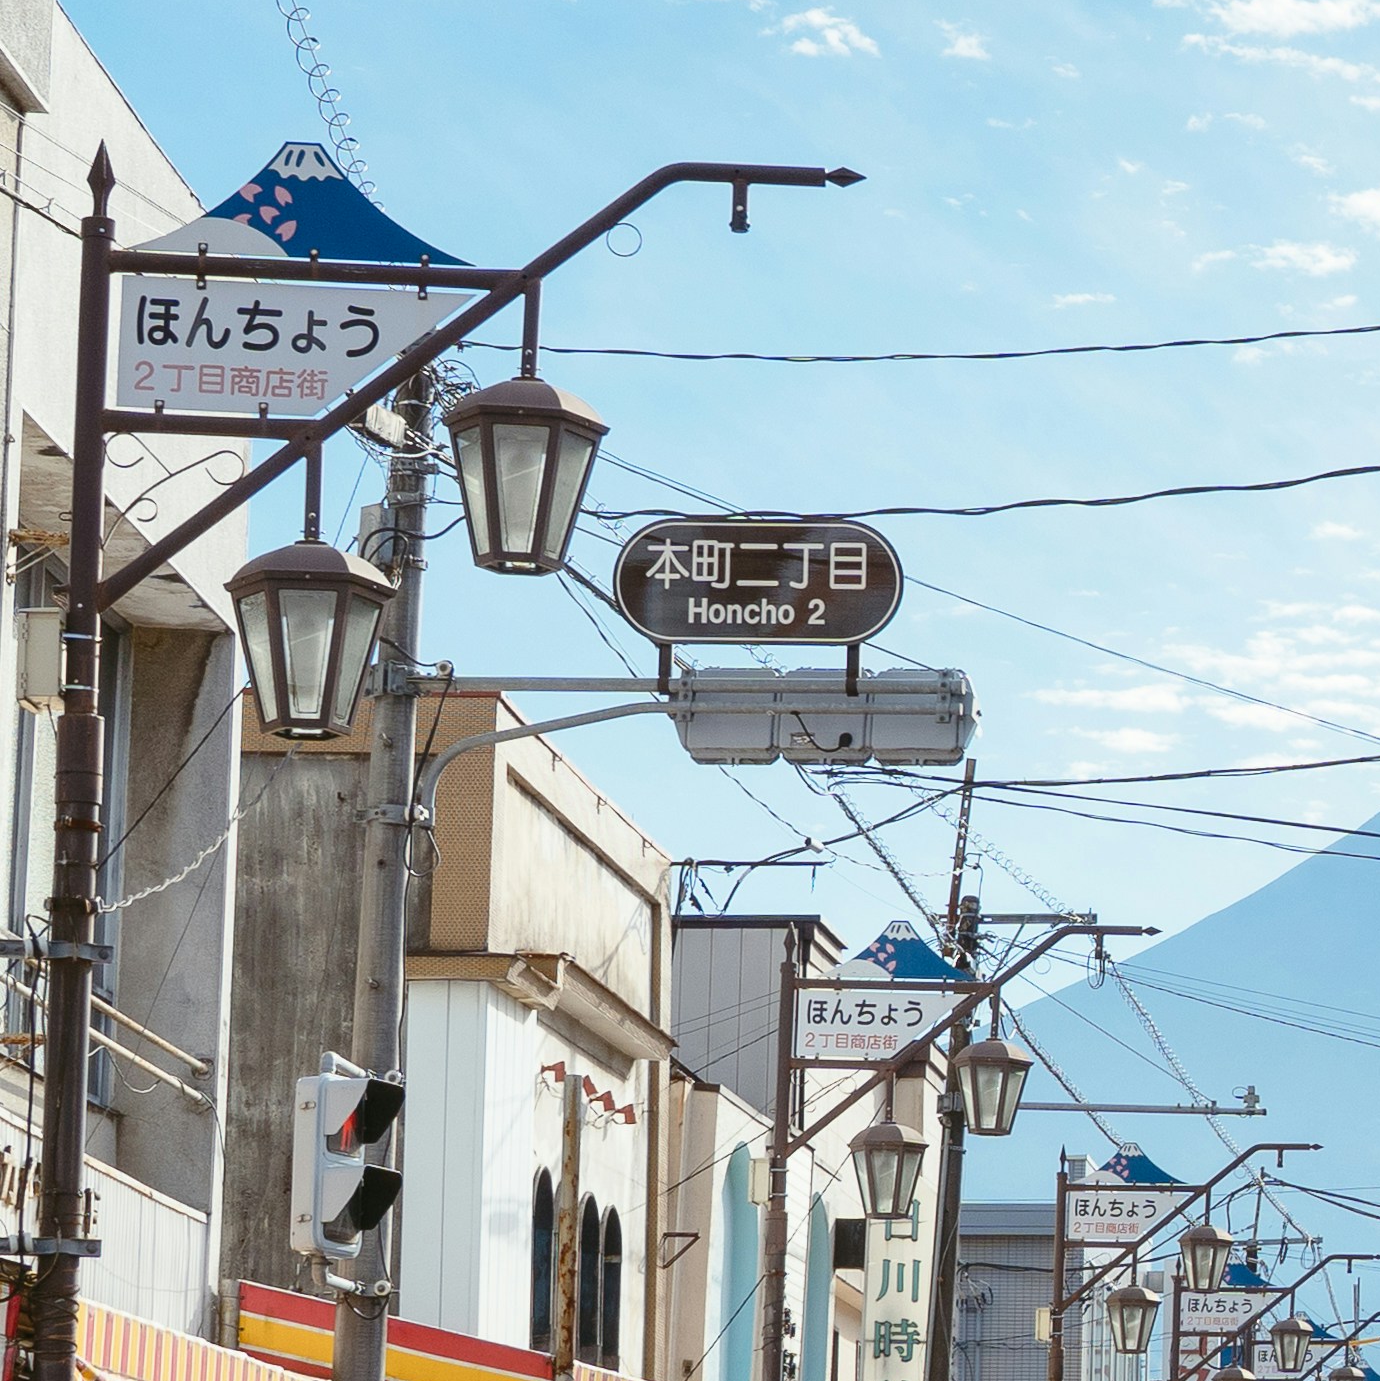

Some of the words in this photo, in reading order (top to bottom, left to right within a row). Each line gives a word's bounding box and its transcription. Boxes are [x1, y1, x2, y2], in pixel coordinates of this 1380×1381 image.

[136, 294, 380, 358] ほんちょう
[133, 360, 329, 401] 2丁目商店街
[645, 537, 867, 590] 本町二丁目
[687, 597, 796, 625] Honcho
[807, 598, 826, 625] 2
[807, 998, 923, 1027] ほんちょう
[804, 1031, 899, 1051] 2丁目商店街
[1074, 1198, 1157, 1219] ほんちょう
[1073, 1221, 1139, 1235] 2丁目商店街
[1187, 1297, 1253, 1315] ほんちょう
